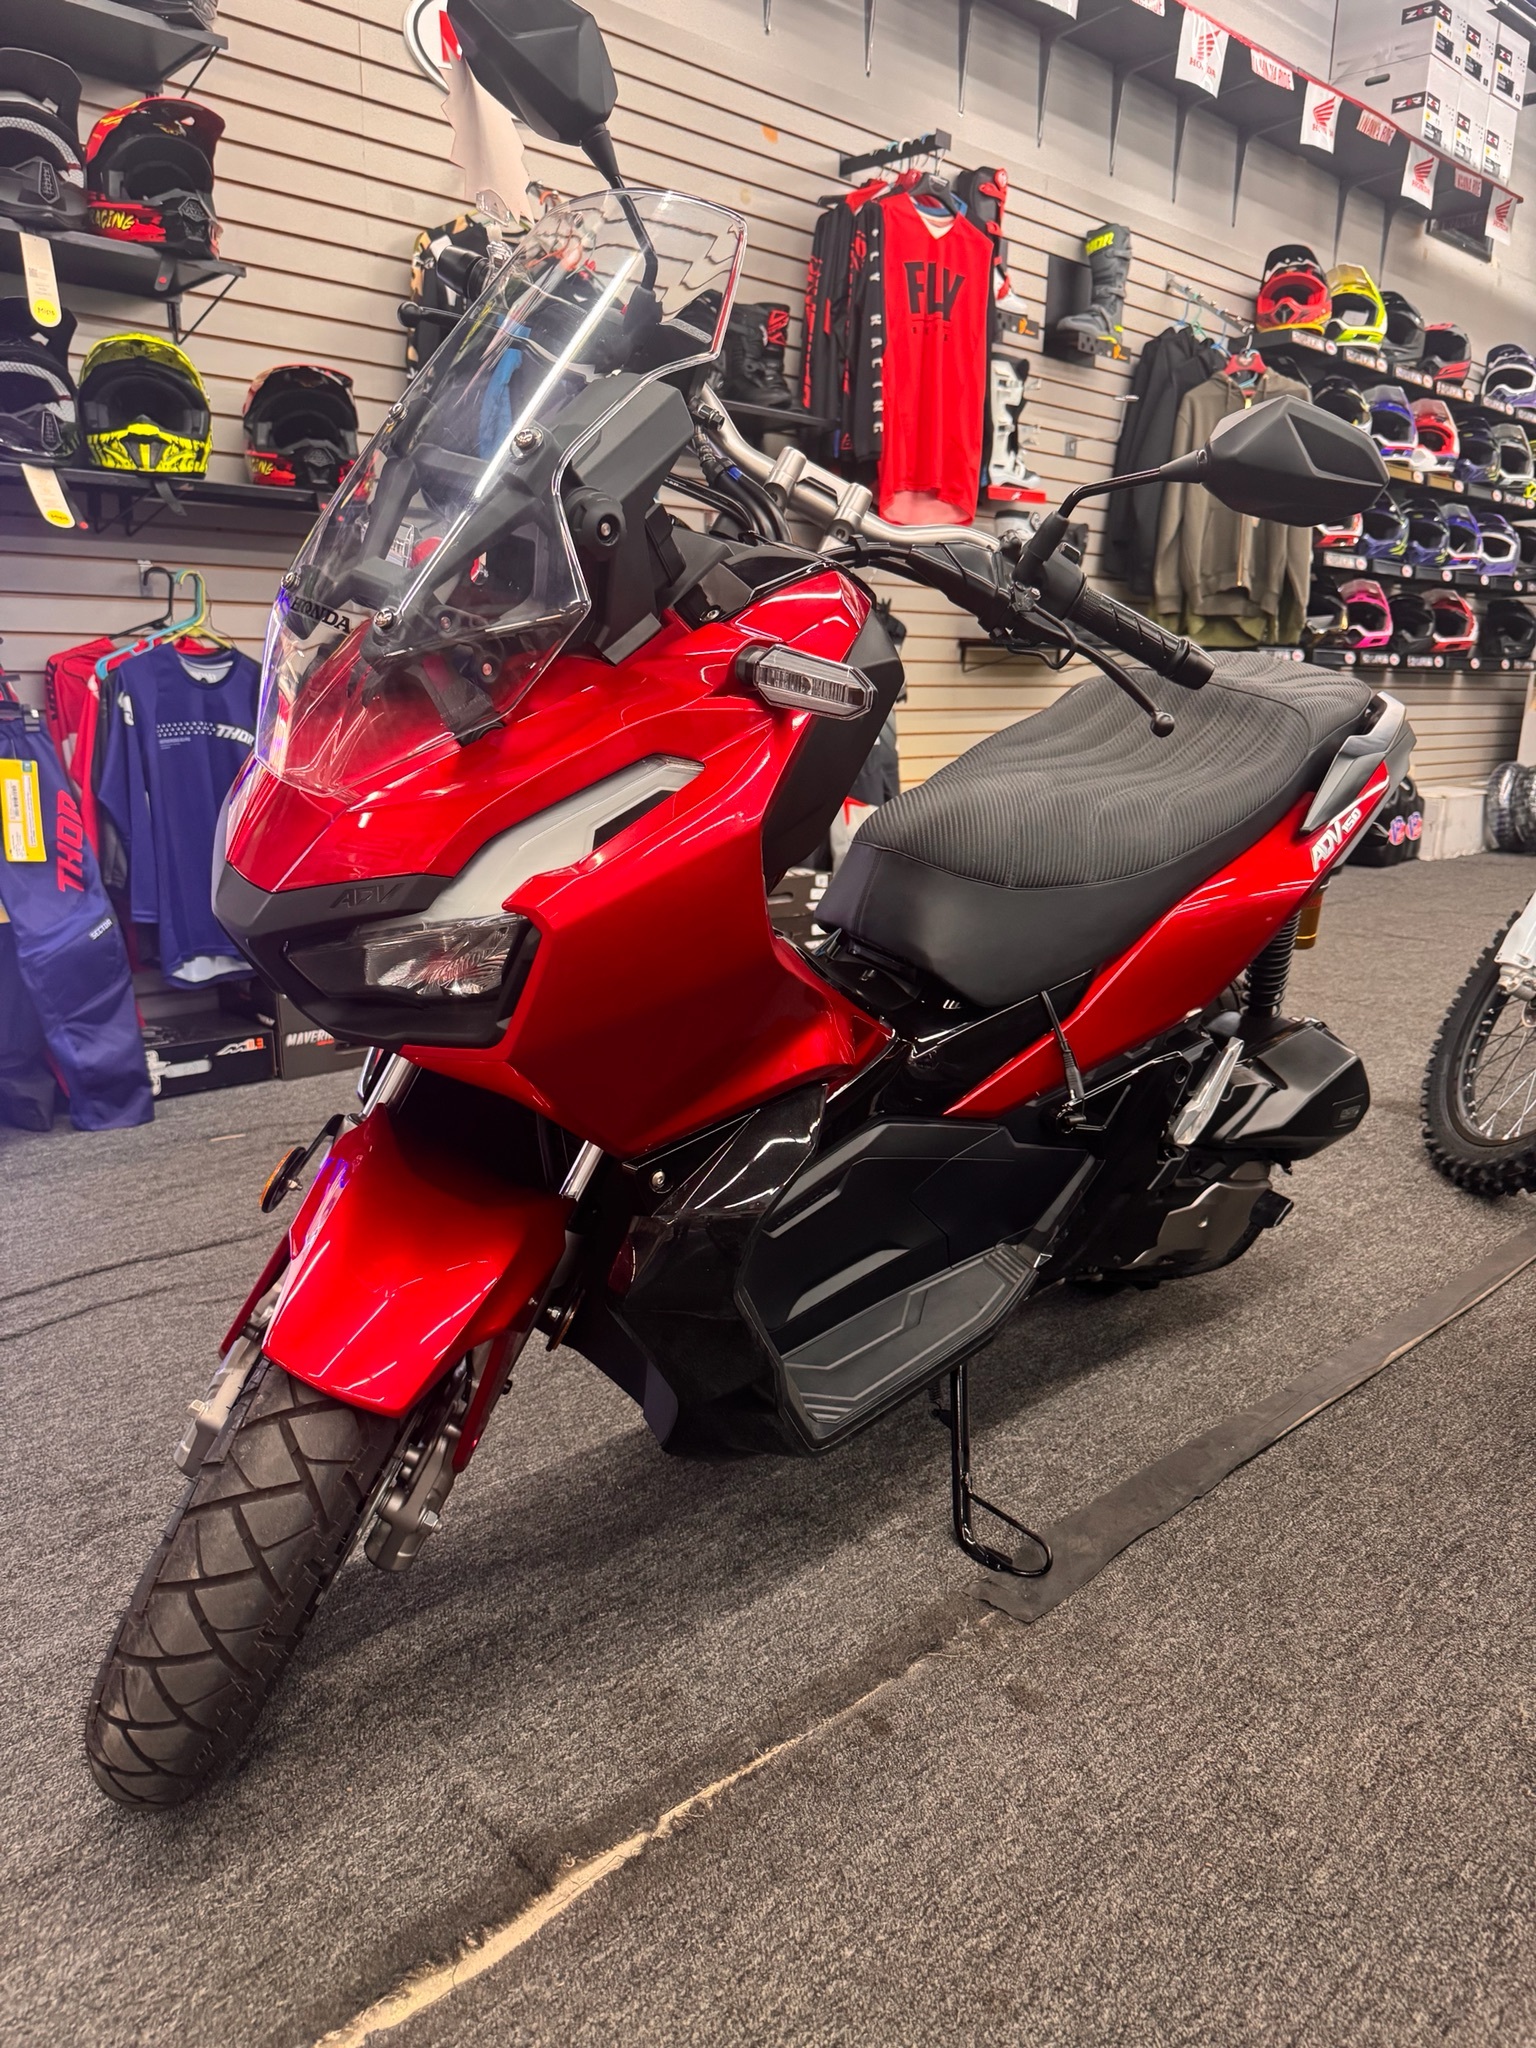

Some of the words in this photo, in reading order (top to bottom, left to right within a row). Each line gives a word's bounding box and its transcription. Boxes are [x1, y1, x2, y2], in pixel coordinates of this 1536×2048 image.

[903, 260, 966, 322] FLY
[290, 596, 351, 635] HONDA
[1311, 820, 1342, 873] ADV
[1341, 807, 1362, 834] 150
[329, 882, 406, 909] ADV
[88, 917, 113, 941] SECTOR
